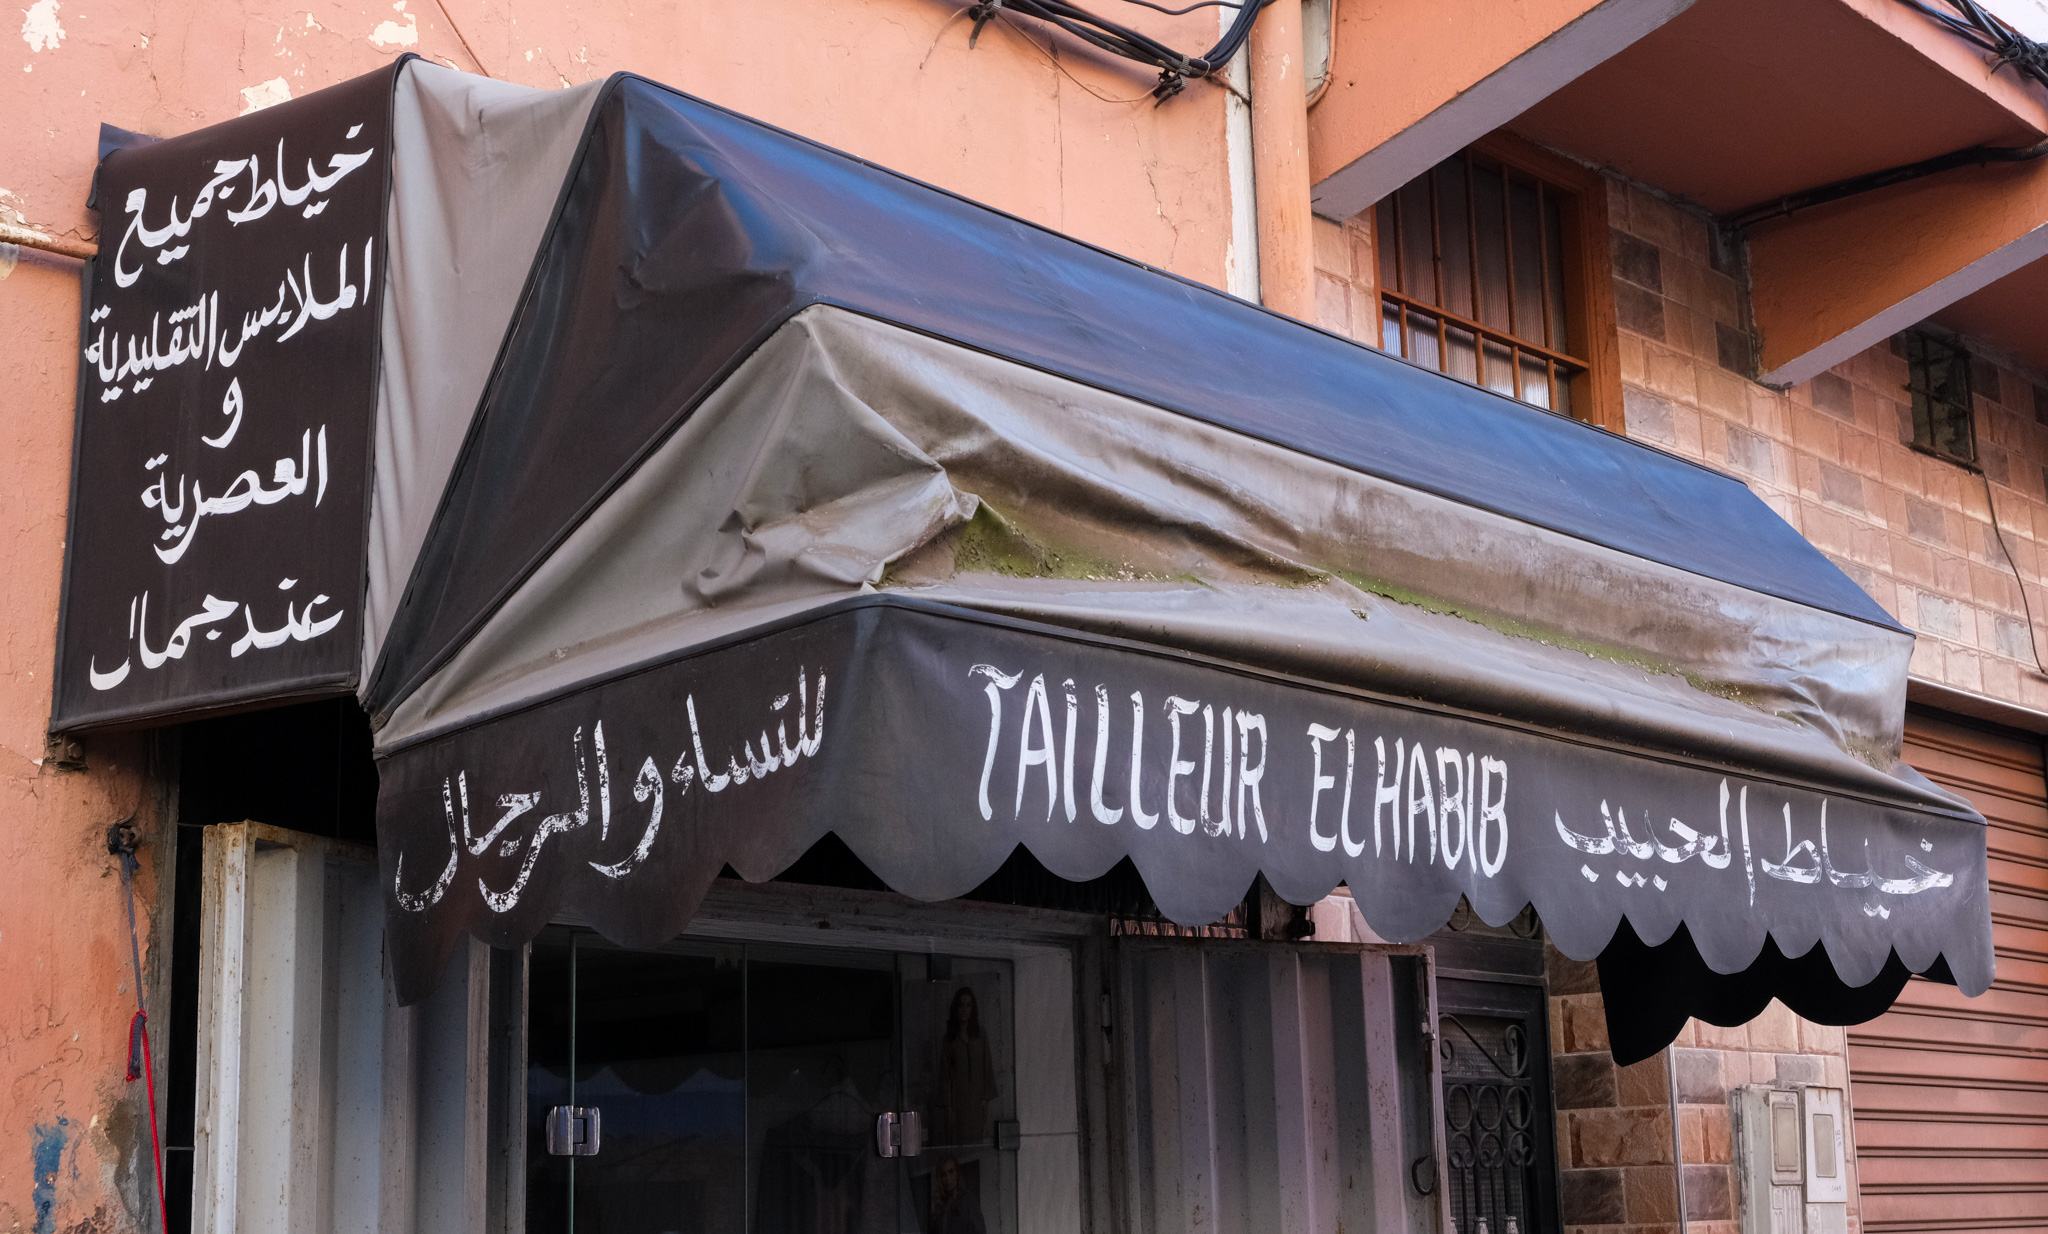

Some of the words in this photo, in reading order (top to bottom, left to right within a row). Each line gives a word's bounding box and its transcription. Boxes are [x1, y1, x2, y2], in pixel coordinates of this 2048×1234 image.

[115, 158, 250, 288] جميع
[227, 123, 374, 228] خياط
[84, 290, 218, 404] التقليدية
[218, 236, 373, 367] الملابس
[202, 376, 244, 448] و
[140, 424, 328, 565] العصرية
[89, 591, 239, 690] جمال
[231, 577, 344, 659] عند
[671, 665, 828, 796] للنساء
[967, 663, 1268, 844] TAILLEUR
[395, 719, 611, 913] الرجال
[1555, 777, 1756, 908] الحبيب
[1761, 798, 1955, 921] خياط
